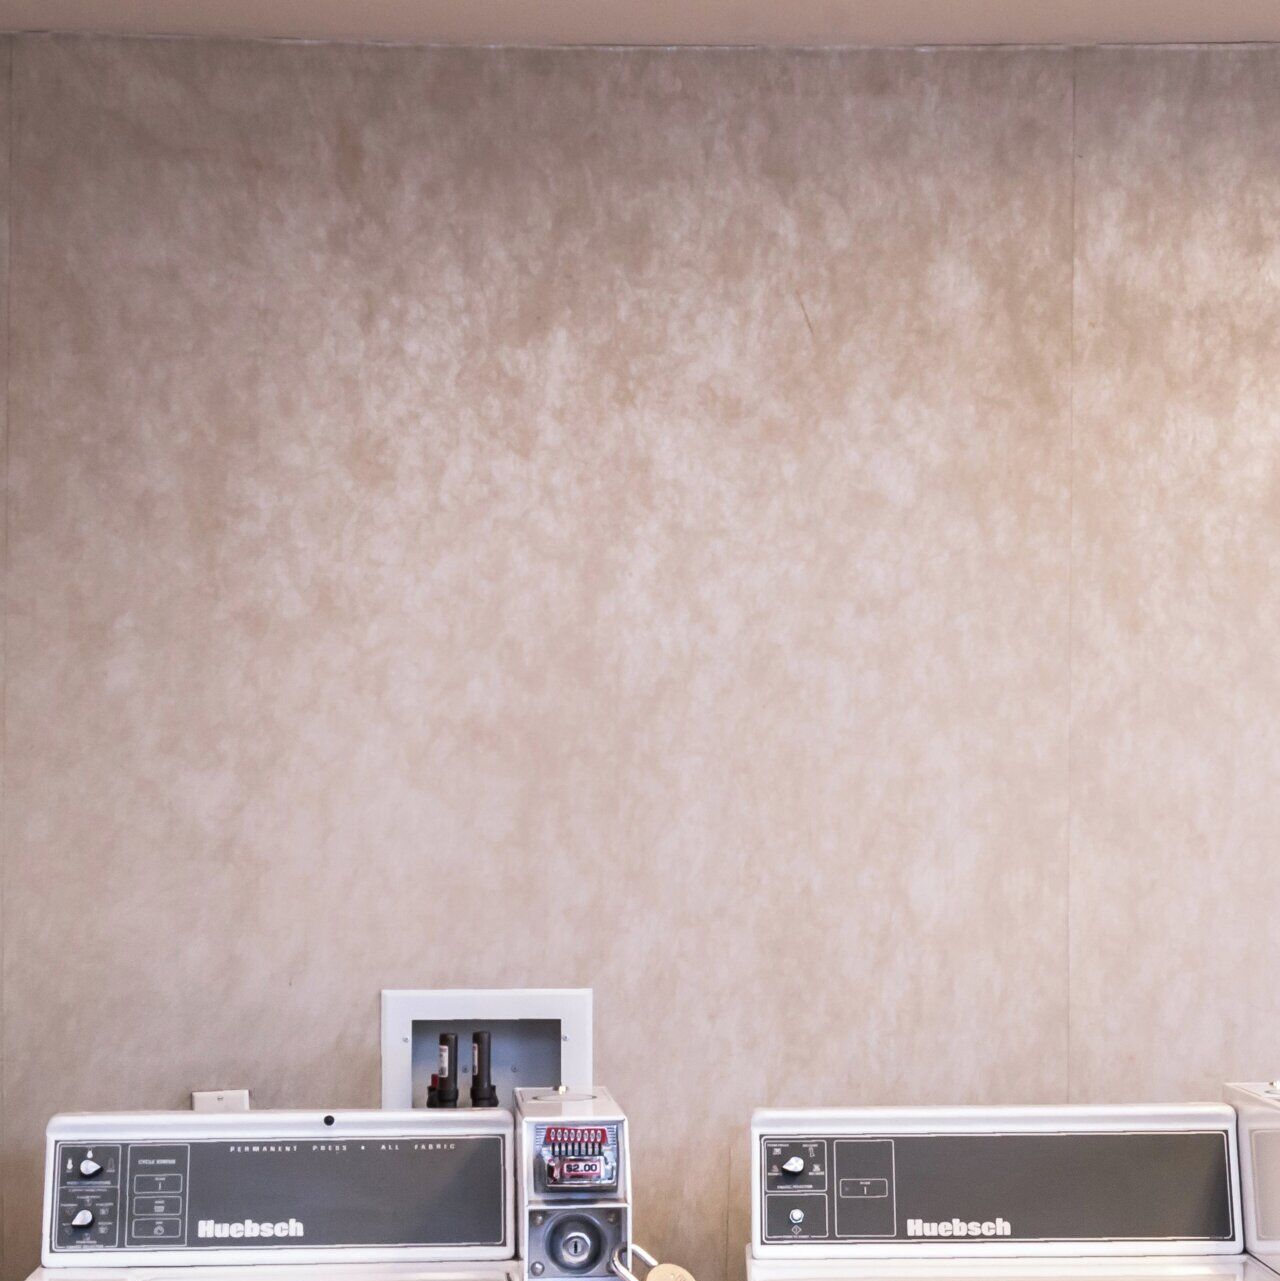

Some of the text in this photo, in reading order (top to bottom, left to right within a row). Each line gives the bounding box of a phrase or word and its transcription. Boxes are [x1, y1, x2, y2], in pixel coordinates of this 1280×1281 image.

[230, 1145, 298, 1153] PERMANENT
[414, 1143, 457, 1151] FABRIC
[565, 1163, 598, 1173] $2.00
[197, 1218, 304, 1238] Huebsch
[907, 1218, 1012, 1237] Huebsch
